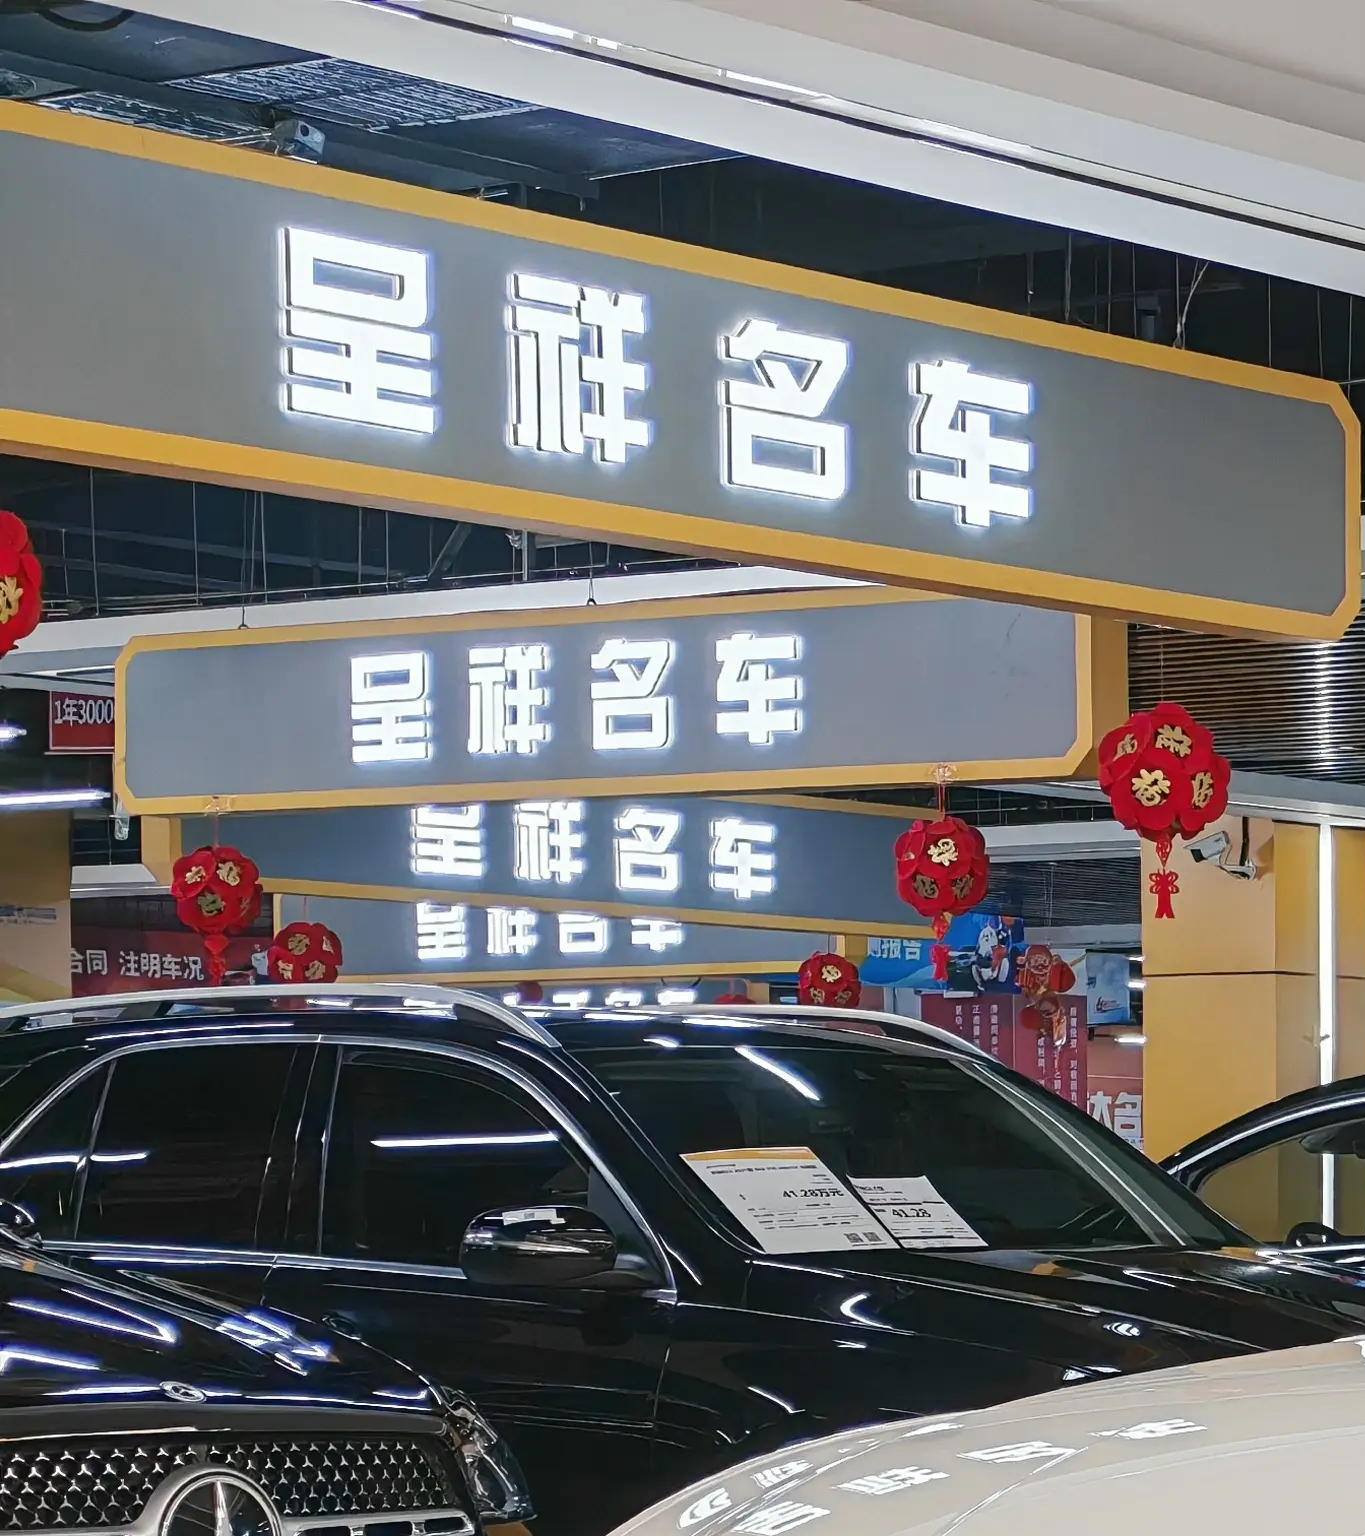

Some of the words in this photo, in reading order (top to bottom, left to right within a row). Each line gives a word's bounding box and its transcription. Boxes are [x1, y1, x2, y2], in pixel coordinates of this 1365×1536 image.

[281, 227, 1032, 528] 呈祥名车
[350, 633, 802, 764] 呈祥名车
[411, 800, 777, 898] 呈祥名车
[119, 950, 205, 981] 注明车况
[891, 1207, 932, 1219] 41.28
